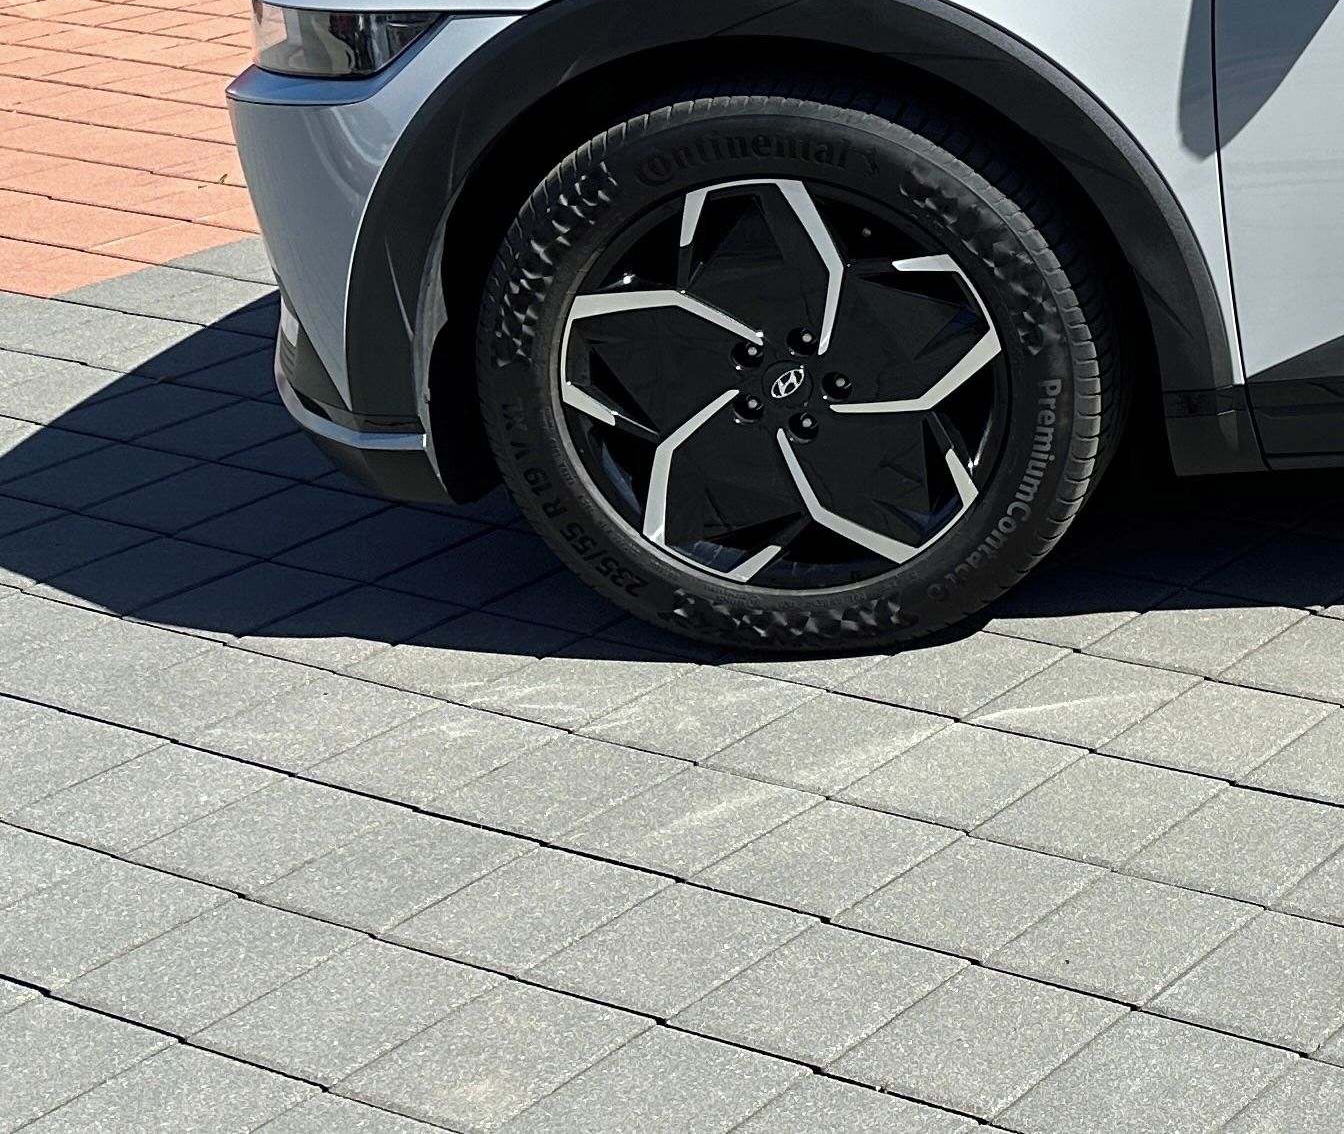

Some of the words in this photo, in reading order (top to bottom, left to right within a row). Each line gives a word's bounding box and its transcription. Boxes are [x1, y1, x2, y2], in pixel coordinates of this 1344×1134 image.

[634, 130, 852, 187] Continental
[523, 467, 553, 497] 19
[542, 497, 568, 519] R
[944, 378, 1062, 585] PremiumContact
[560, 521, 649, 598] 235/55
